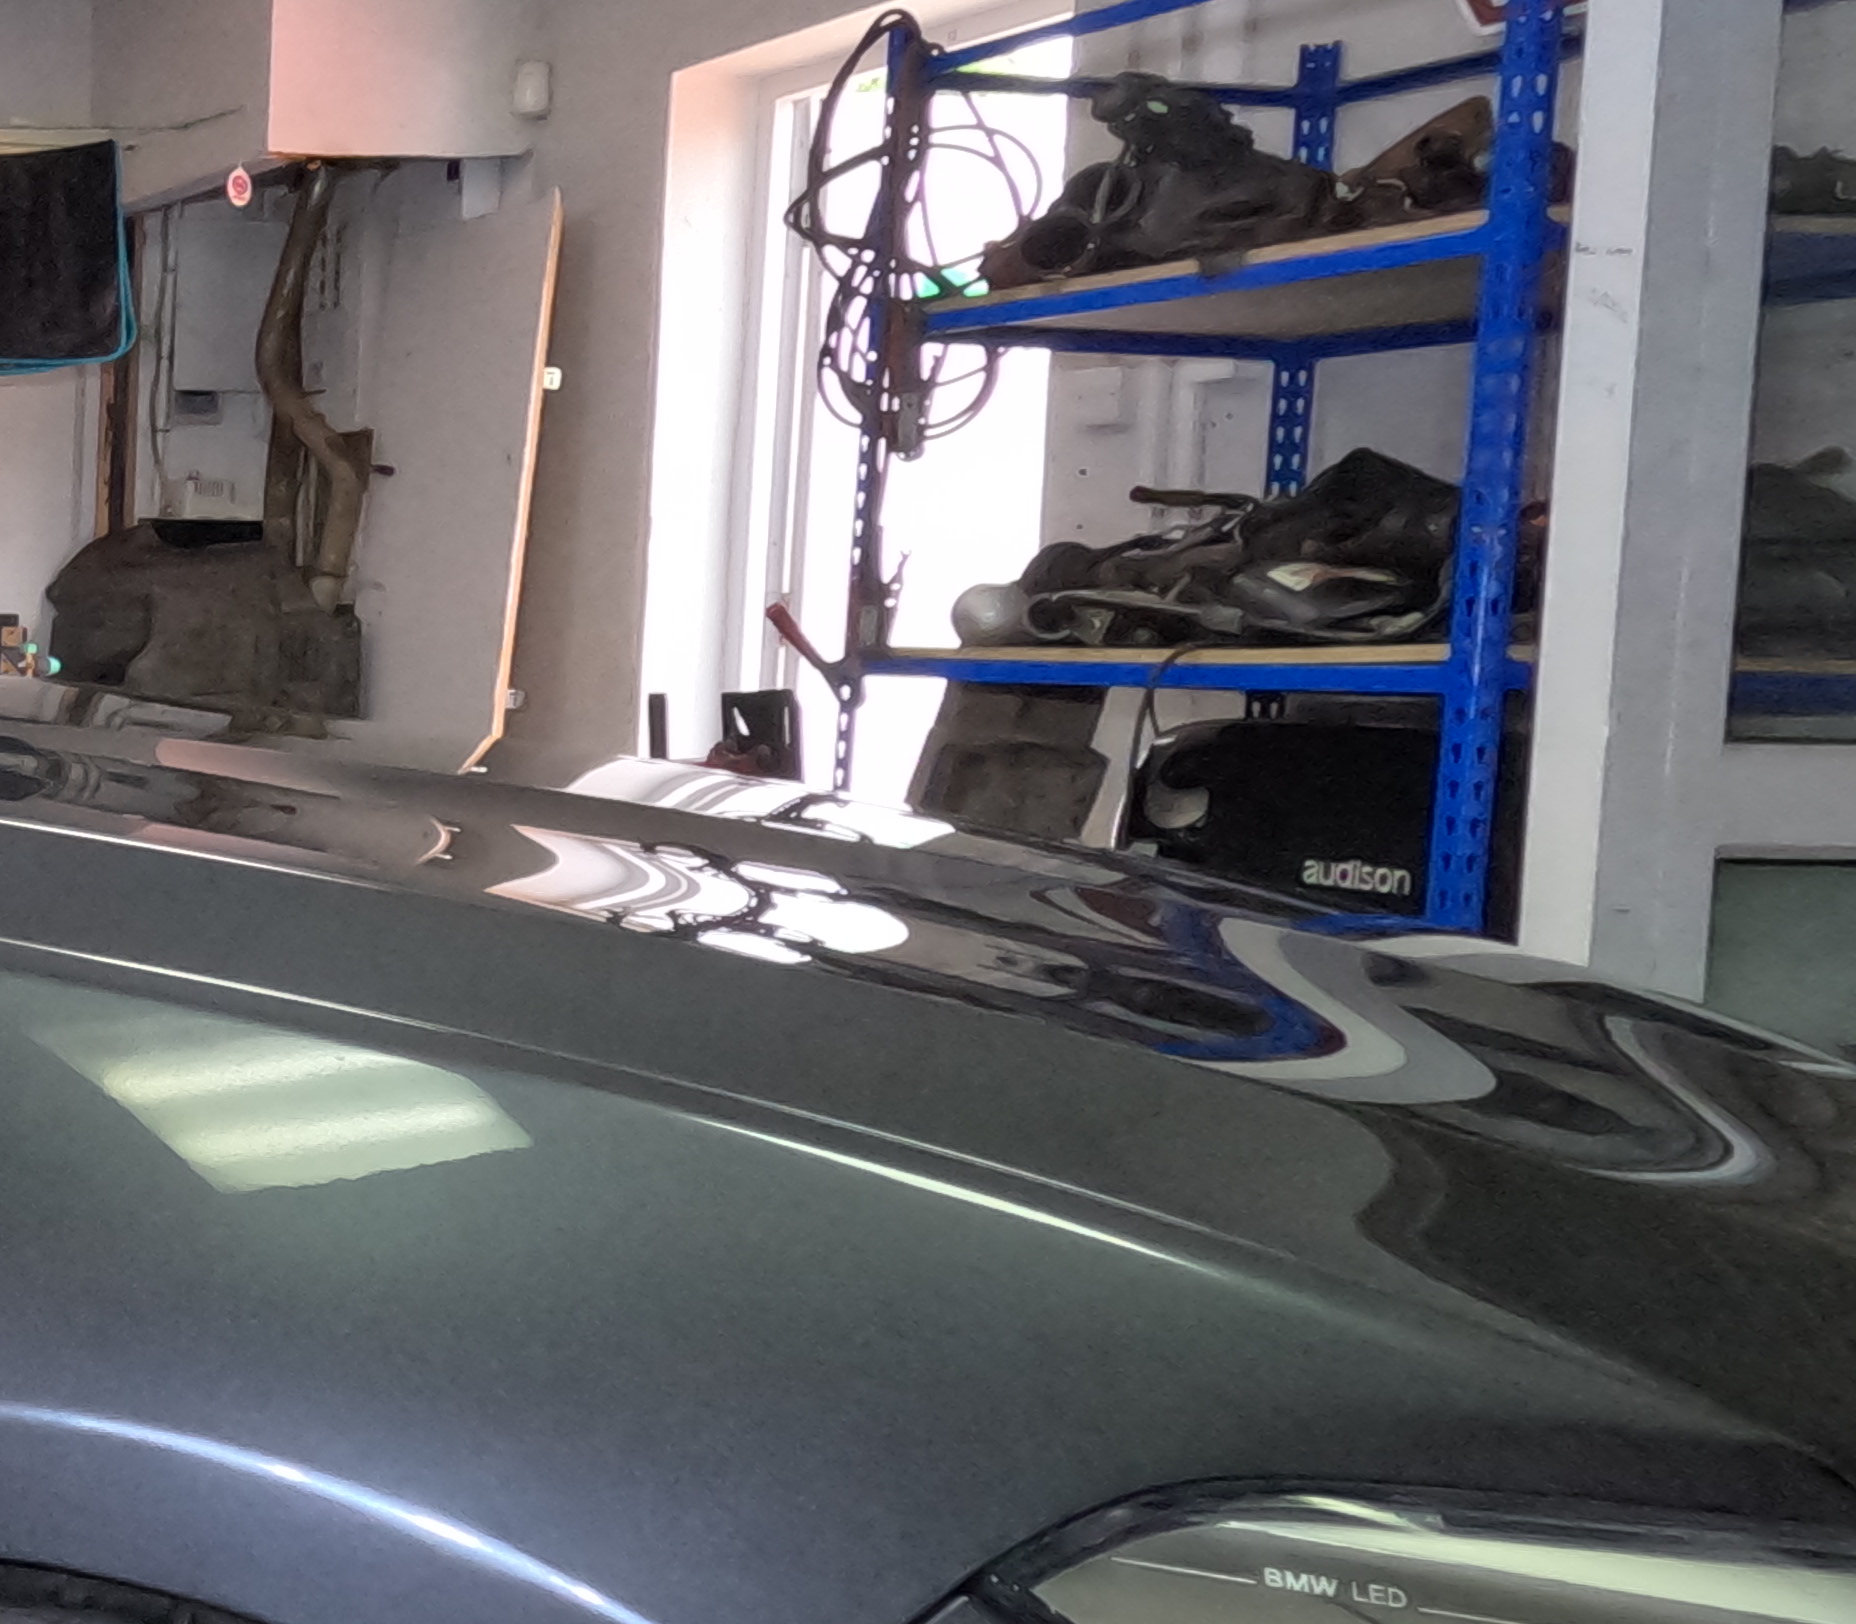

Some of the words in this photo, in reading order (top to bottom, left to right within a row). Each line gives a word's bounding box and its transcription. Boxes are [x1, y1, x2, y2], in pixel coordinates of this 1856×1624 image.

[1302, 859, 1413, 897] audison
[1263, 1566, 1340, 1599] BMW
[1350, 1580, 1409, 1609] LED
